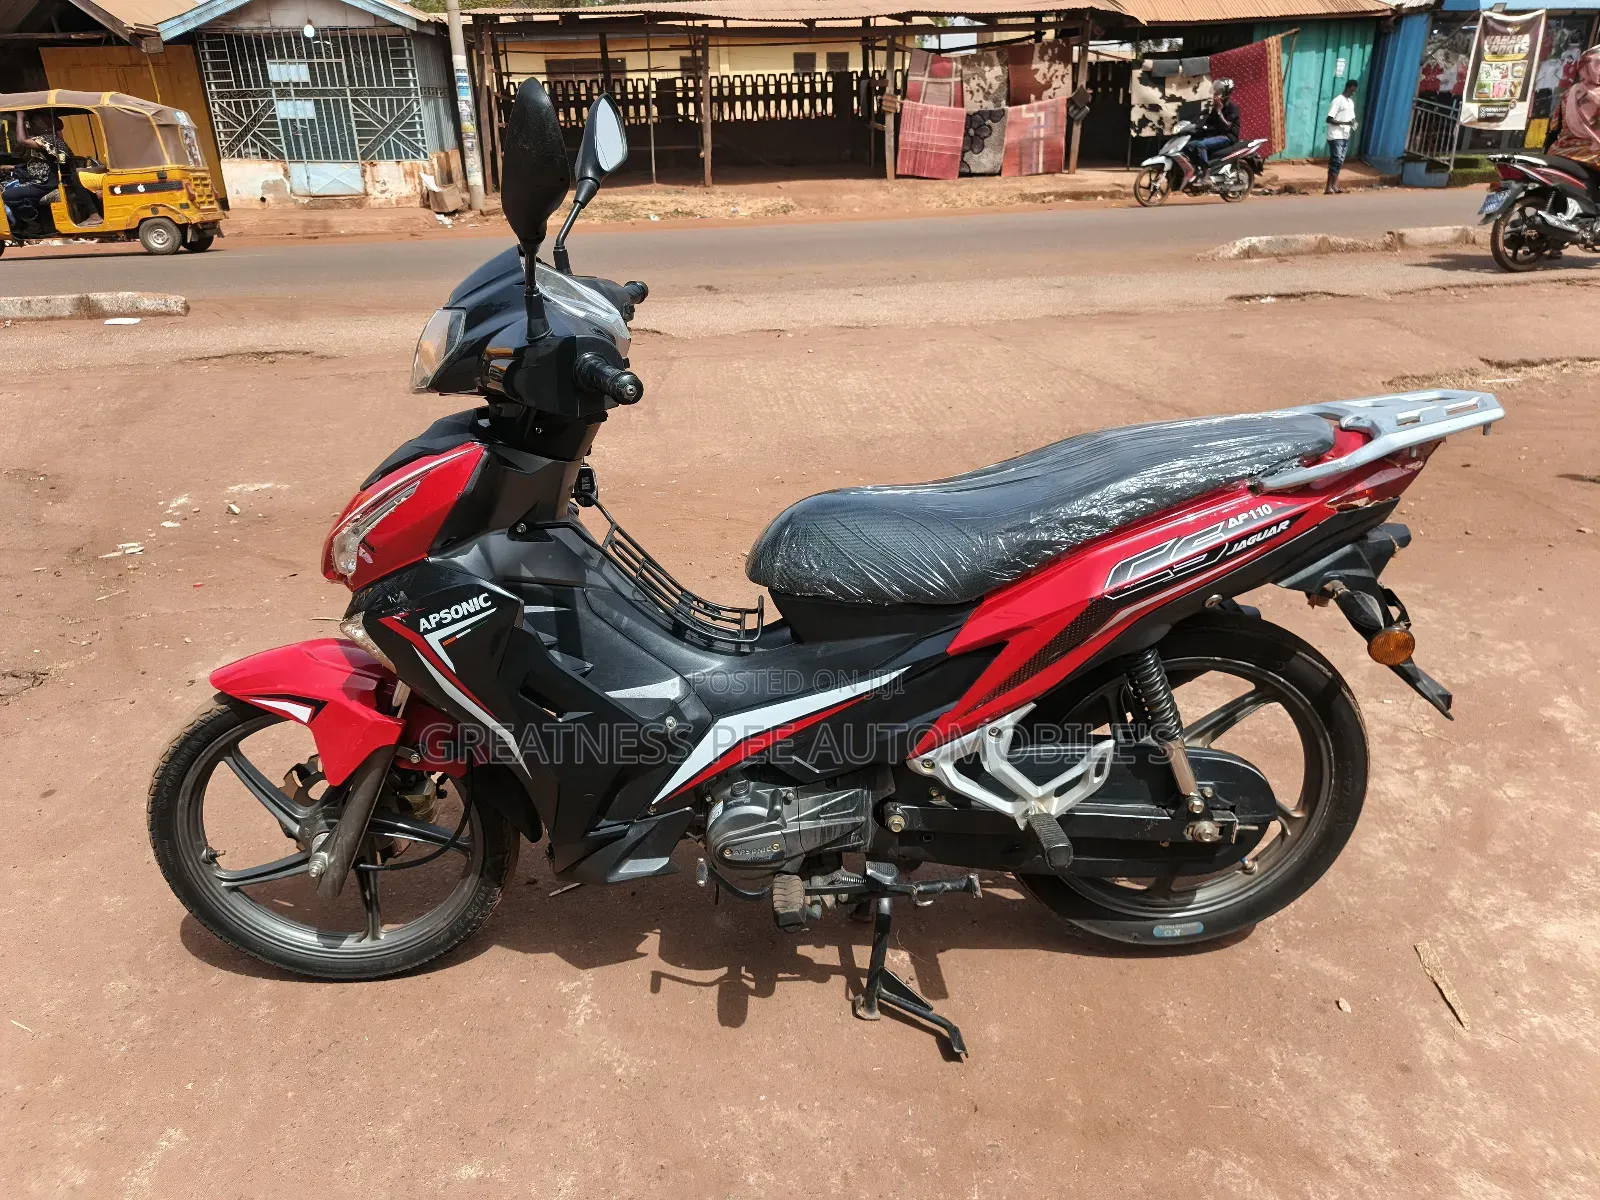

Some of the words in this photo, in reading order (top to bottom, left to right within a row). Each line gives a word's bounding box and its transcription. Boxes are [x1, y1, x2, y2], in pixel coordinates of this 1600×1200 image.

[1227, 504, 1273, 528] AP110
[1226, 519, 1291, 556] JAGUAR
[419, 593, 492, 632] APSONIC
